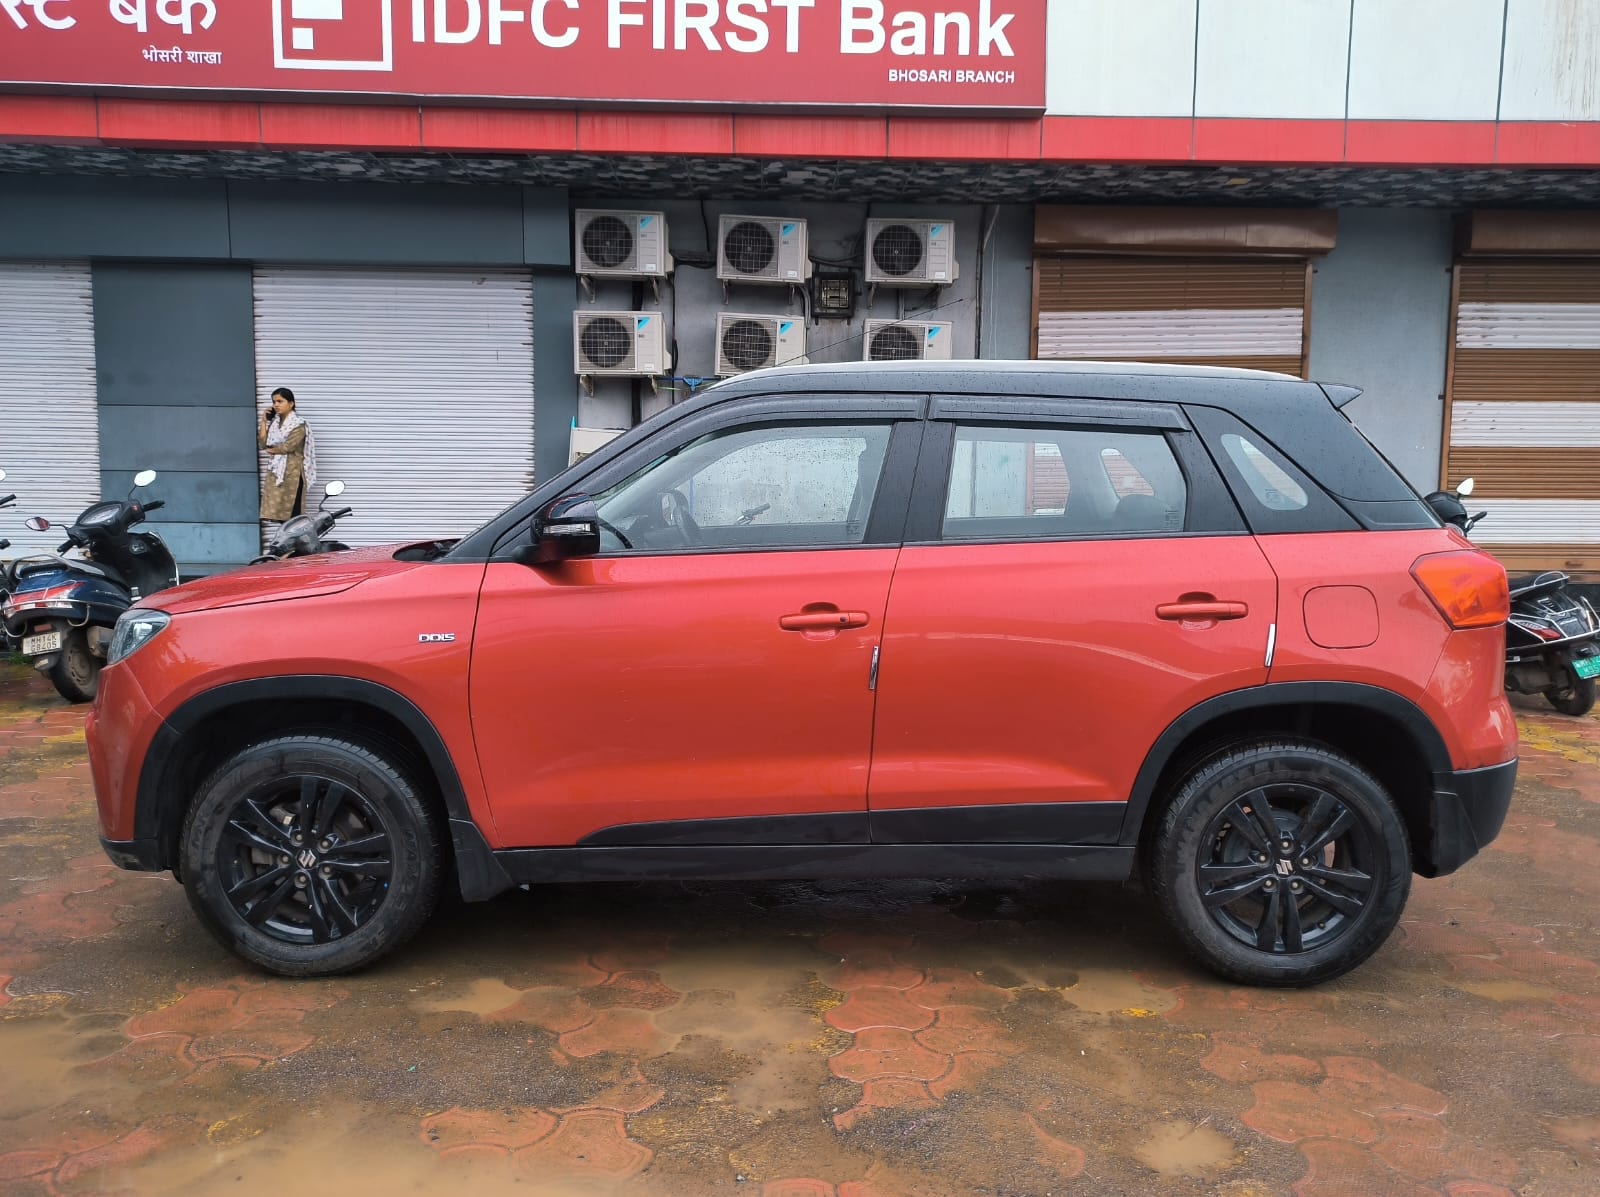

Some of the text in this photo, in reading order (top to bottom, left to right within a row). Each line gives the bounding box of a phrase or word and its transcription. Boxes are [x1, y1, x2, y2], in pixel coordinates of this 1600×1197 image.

[411, 0, 1016, 57] IDFC FIRST Bank
[142, 45, 222, 64] भोसरी शाखा
[888, 69, 1015, 83] BHOSARI BRANCH
